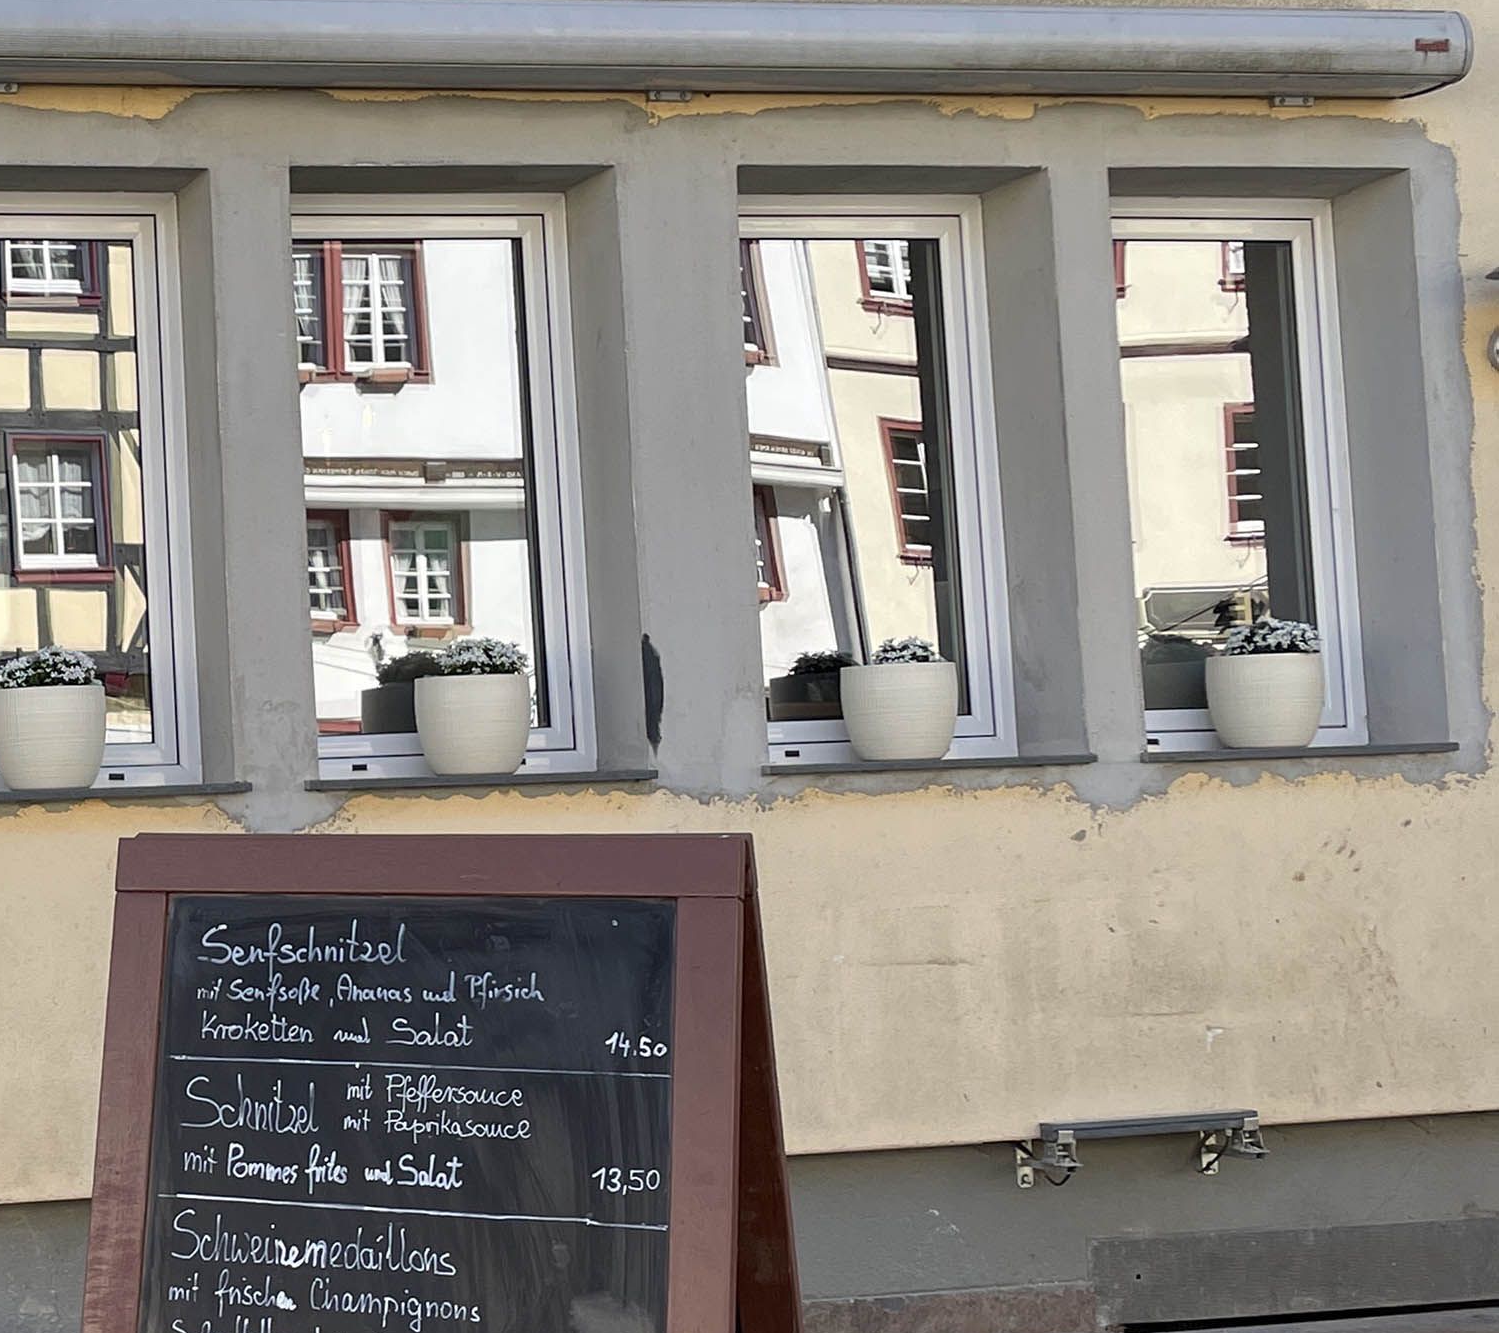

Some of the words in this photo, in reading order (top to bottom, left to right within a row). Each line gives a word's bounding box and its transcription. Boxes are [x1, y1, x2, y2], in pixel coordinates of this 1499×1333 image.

[198, 919, 406, 979] Senfschnitzel
[197, 979, 222, 1001] mit
[422, 971, 455, 1003] und
[465, 972, 544, 1017] Pfirsich
[200, 1012, 314, 1044] Kroketten
[386, 1012, 474, 1047] Salat
[180, 1073, 320, 1134] Schnitzel
[346, 1077, 373, 1101] mit
[385, 1073, 524, 1114] Pfeffersauce
[343, 1112, 371, 1134] mit
[384, 1110, 531, 1146] Paprikasauce
[183, 1144, 218, 1174] mit
[226, 1143, 298, 1185] Pommes
[306, 1143, 348, 1195] frites
[365, 1158, 394, 1186] und
[397, 1154, 463, 1189] Salat
[591, 1167, 661, 1197] 13,50
[171, 1209, 456, 1276] Schweinemedaillons
[168, 1272, 199, 1303] mit
[309, 1278, 481, 1332] Champignons
